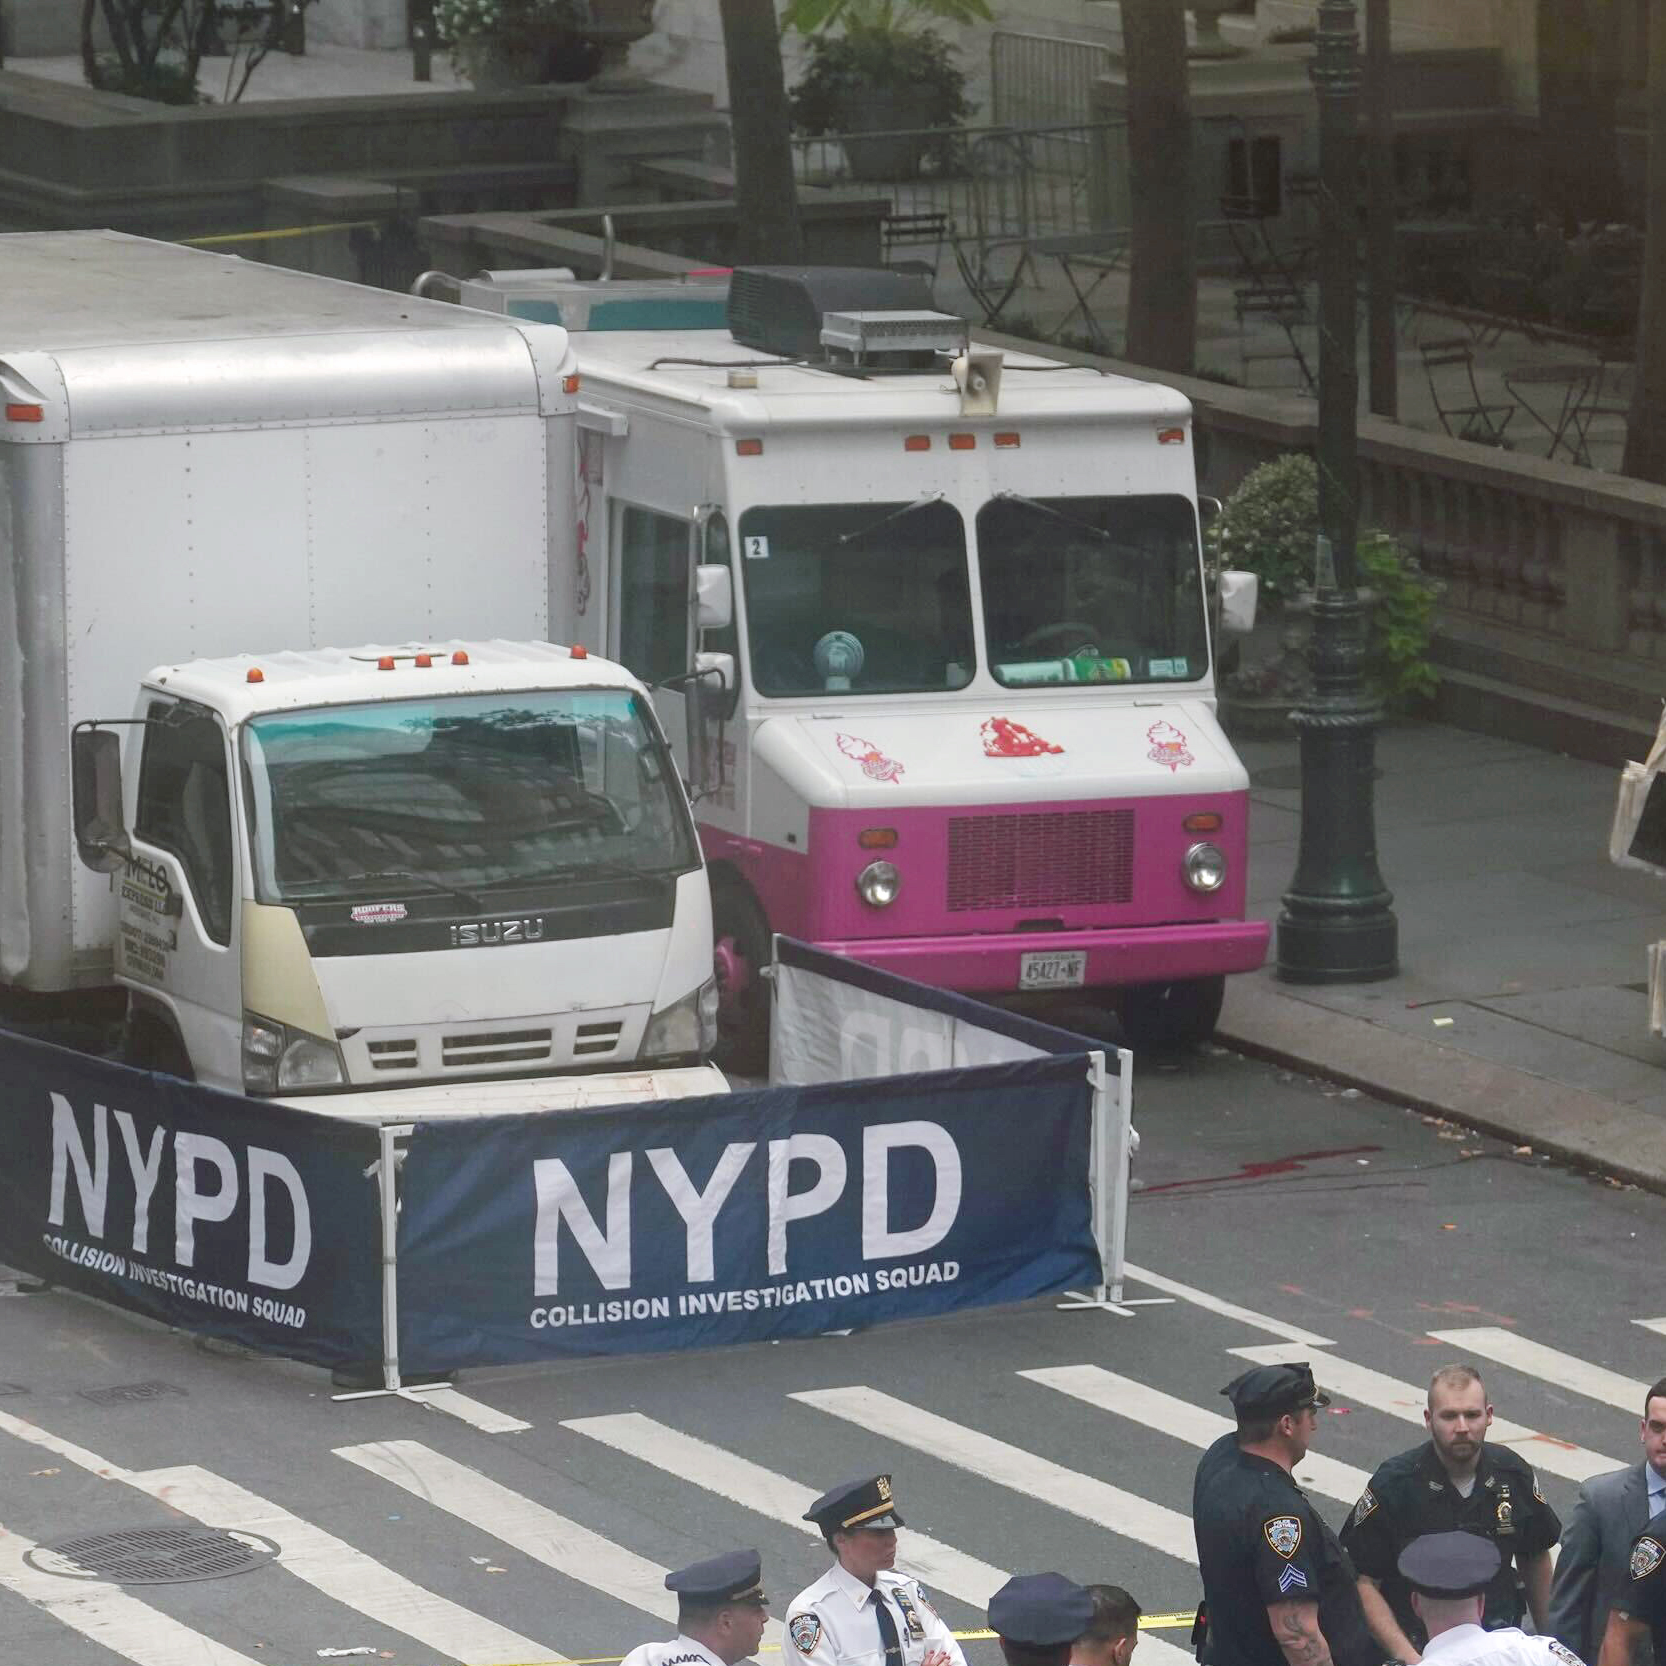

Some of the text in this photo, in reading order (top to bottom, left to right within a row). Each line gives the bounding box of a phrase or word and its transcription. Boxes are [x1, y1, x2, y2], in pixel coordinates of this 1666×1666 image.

[751, 539, 762, 556] 2
[450, 918, 543, 945] ISUZU
[48, 1091, 312, 1291] NYPD
[533, 1120, 963, 1297] NYPD
[42, 1234, 307, 1329] COLLISION INVESTIGATION SQUAD
[530, 1261, 961, 1329] COLLISION INVESTIGATION SQUAD
